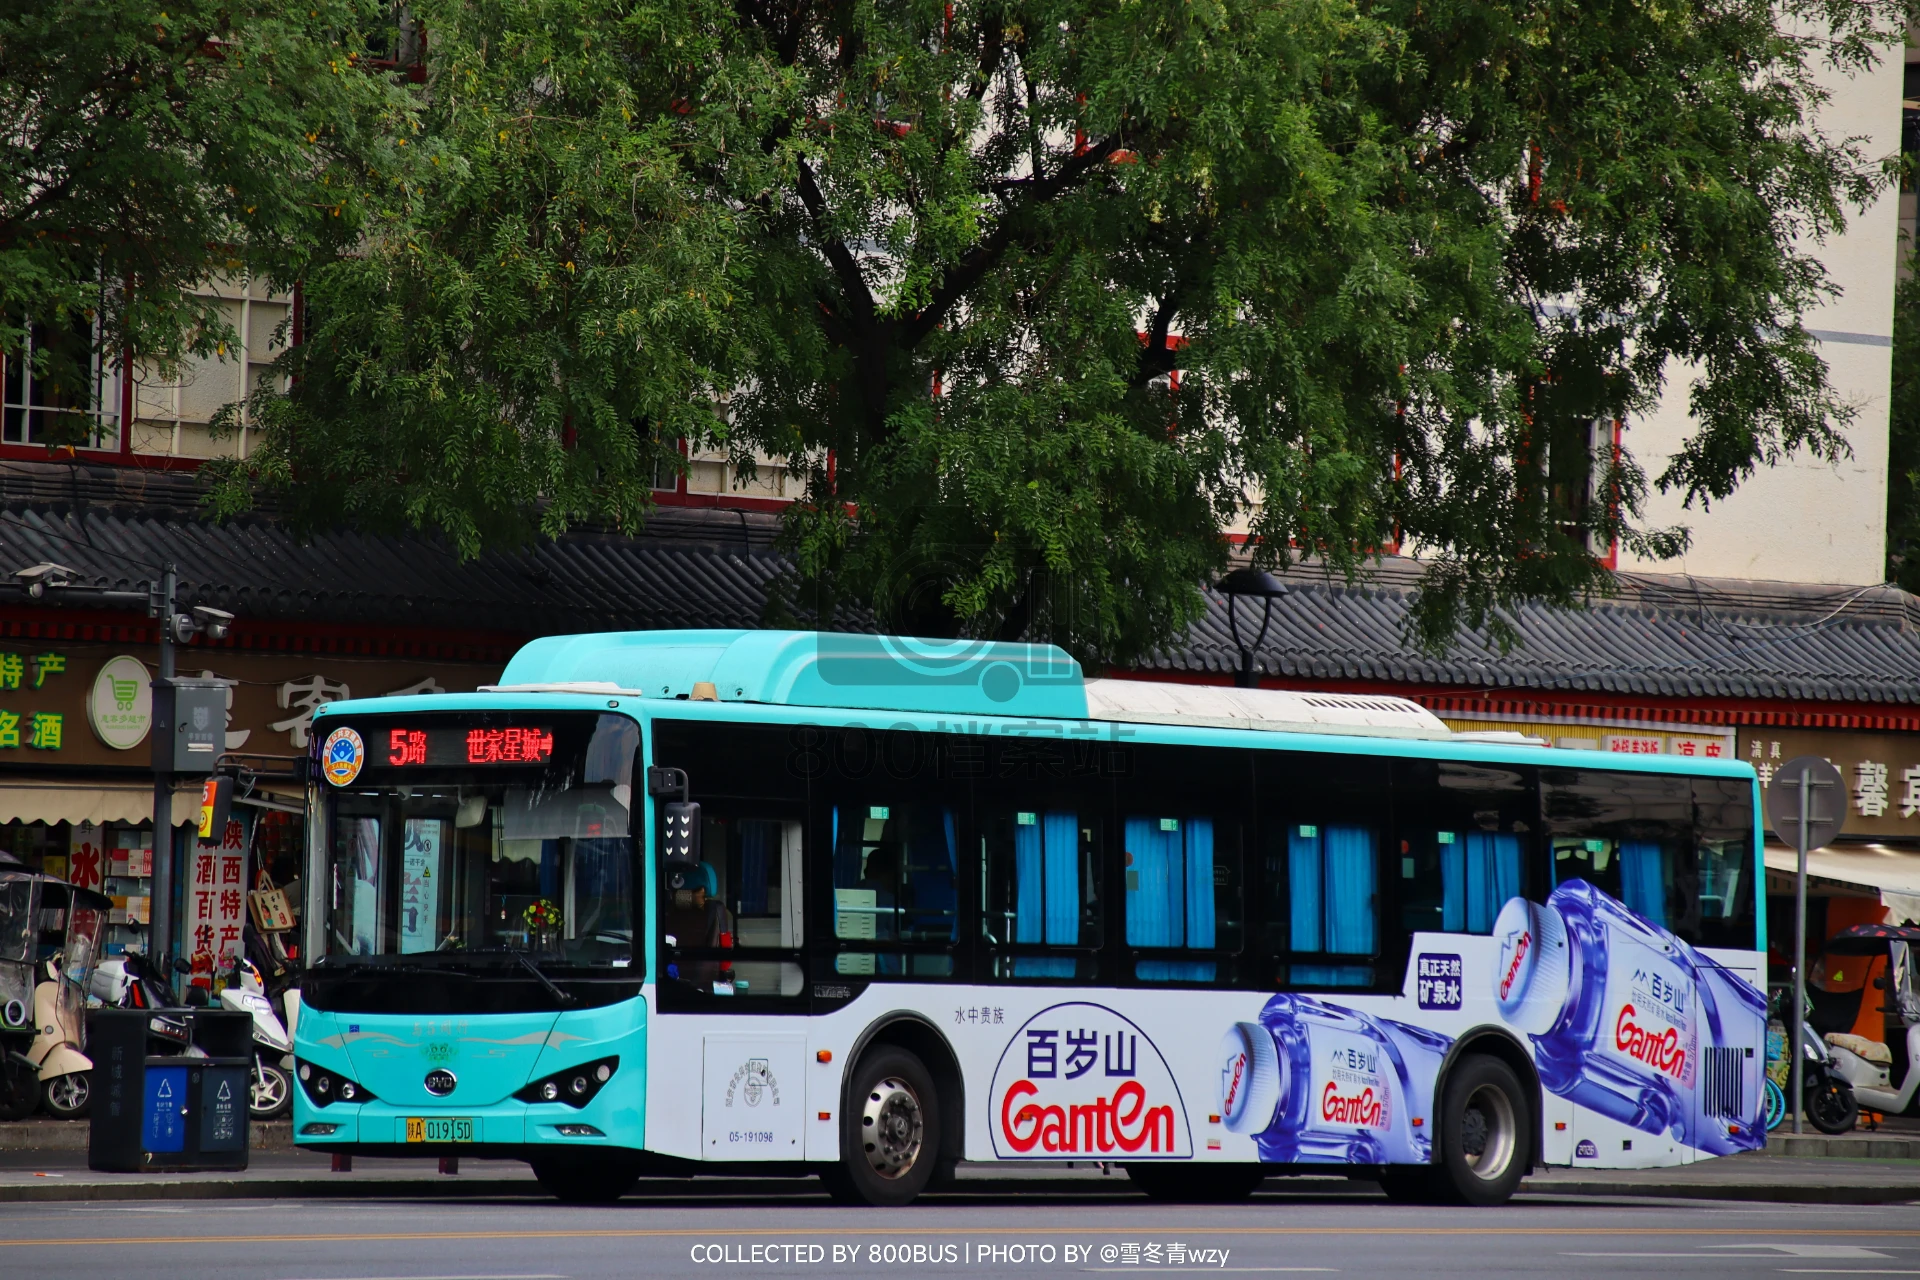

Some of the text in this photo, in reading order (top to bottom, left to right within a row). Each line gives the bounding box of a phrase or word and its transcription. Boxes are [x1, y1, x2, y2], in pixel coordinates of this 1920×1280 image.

[0, 652, 66, 690] 特产
[0, 710, 63, 750] 名酒
[389, 729, 426, 766] 5路
[1751, 740, 1782, 759] 清真
[1419, 959, 1461, 976] 真正天然
[1419, 980, 1461, 1004] 矿泉水
[1652, 972, 1684, 1014] 百岁山
[954, 1006, 1005, 1025] 水中贵族
[1027, 1028, 1136, 1080] 百岁山
[1615, 1003, 1686, 1079] Ganten
[1347, 1049, 1377, 1073] 百岁山
[1001, 1080, 1174, 1153] Ganten
[1322, 1081, 1382, 1127] Ganten
[729, 1131, 774, 1142] 05-191098
